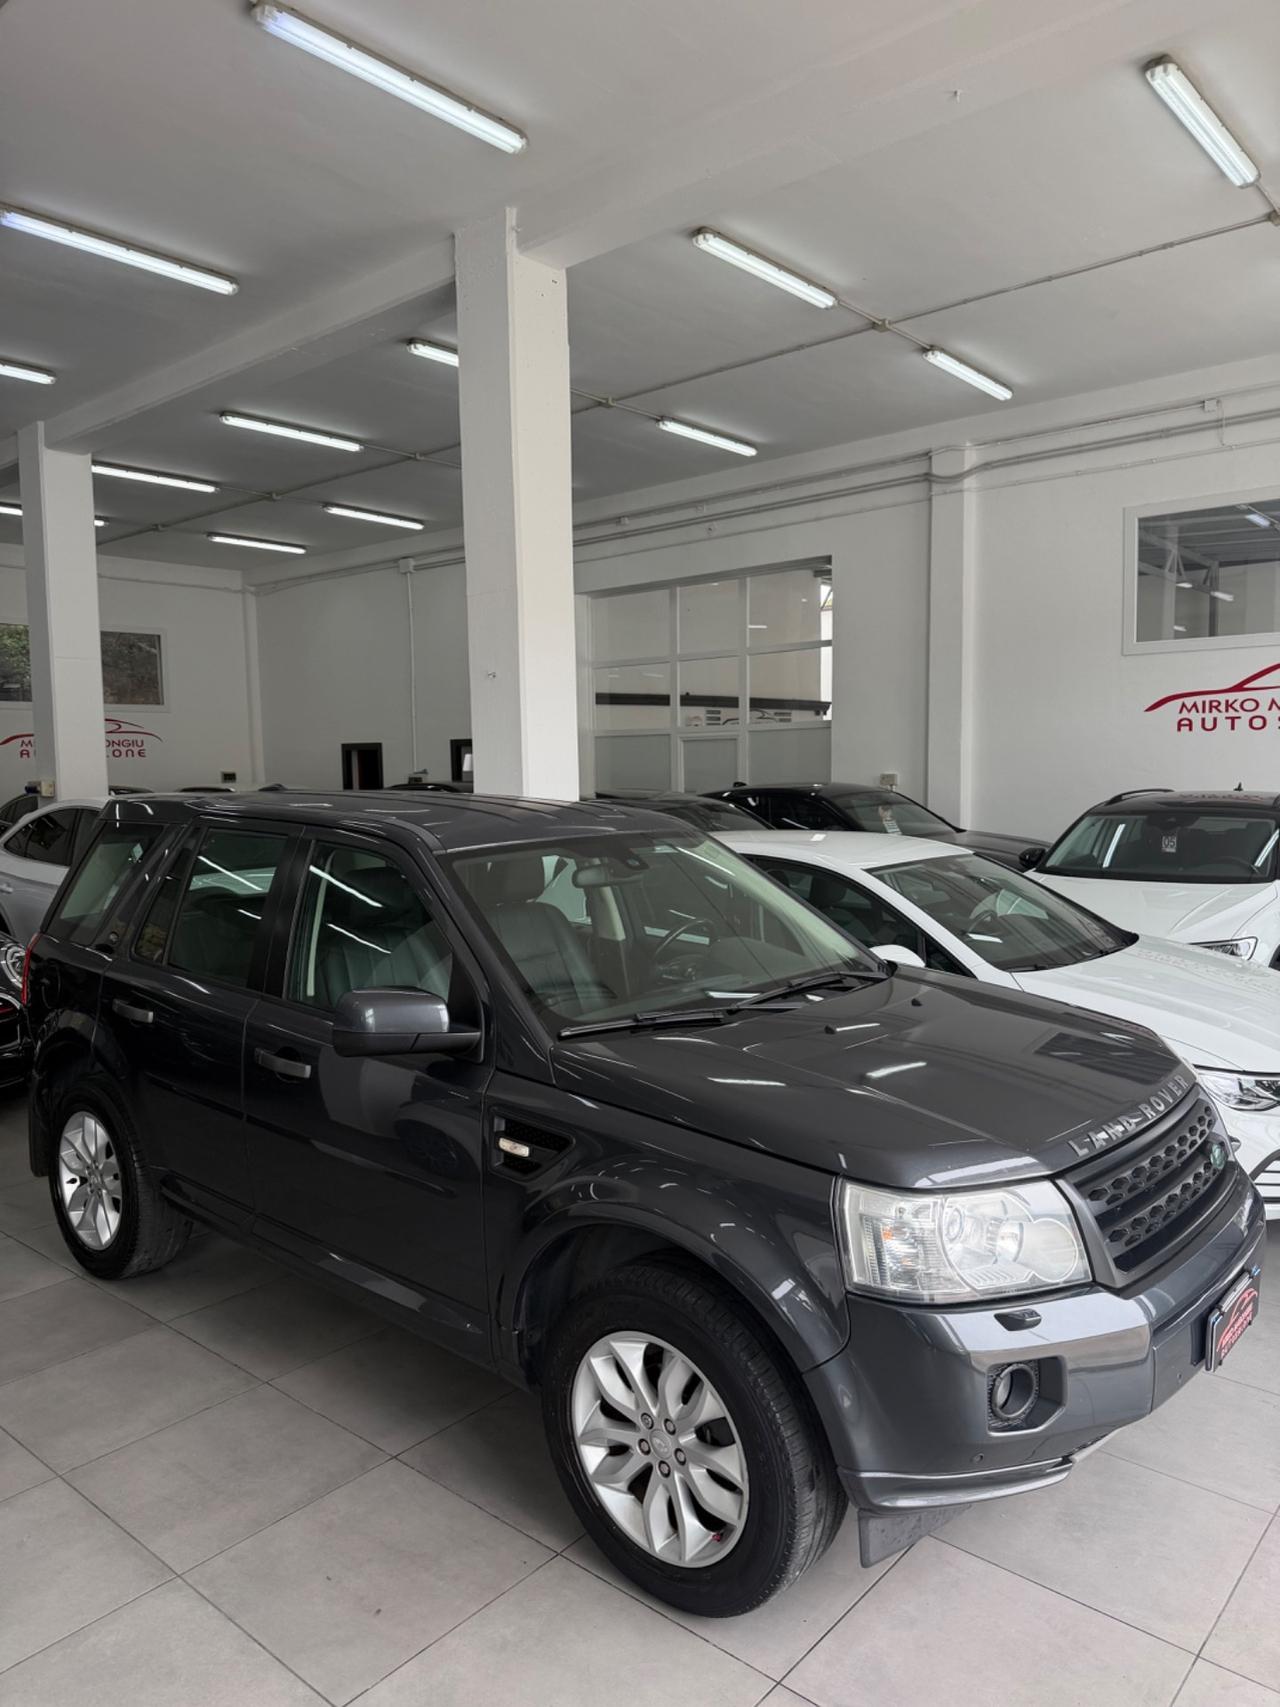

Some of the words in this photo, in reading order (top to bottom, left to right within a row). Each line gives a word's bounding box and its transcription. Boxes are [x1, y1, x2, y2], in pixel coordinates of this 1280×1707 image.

[1179, 698, 1260, 714] MIRKO
[1177, 715, 1280, 732] AUTO
[1068, 1116, 1137, 1157] LAND
[1138, 1075, 1189, 1120] ROVER
